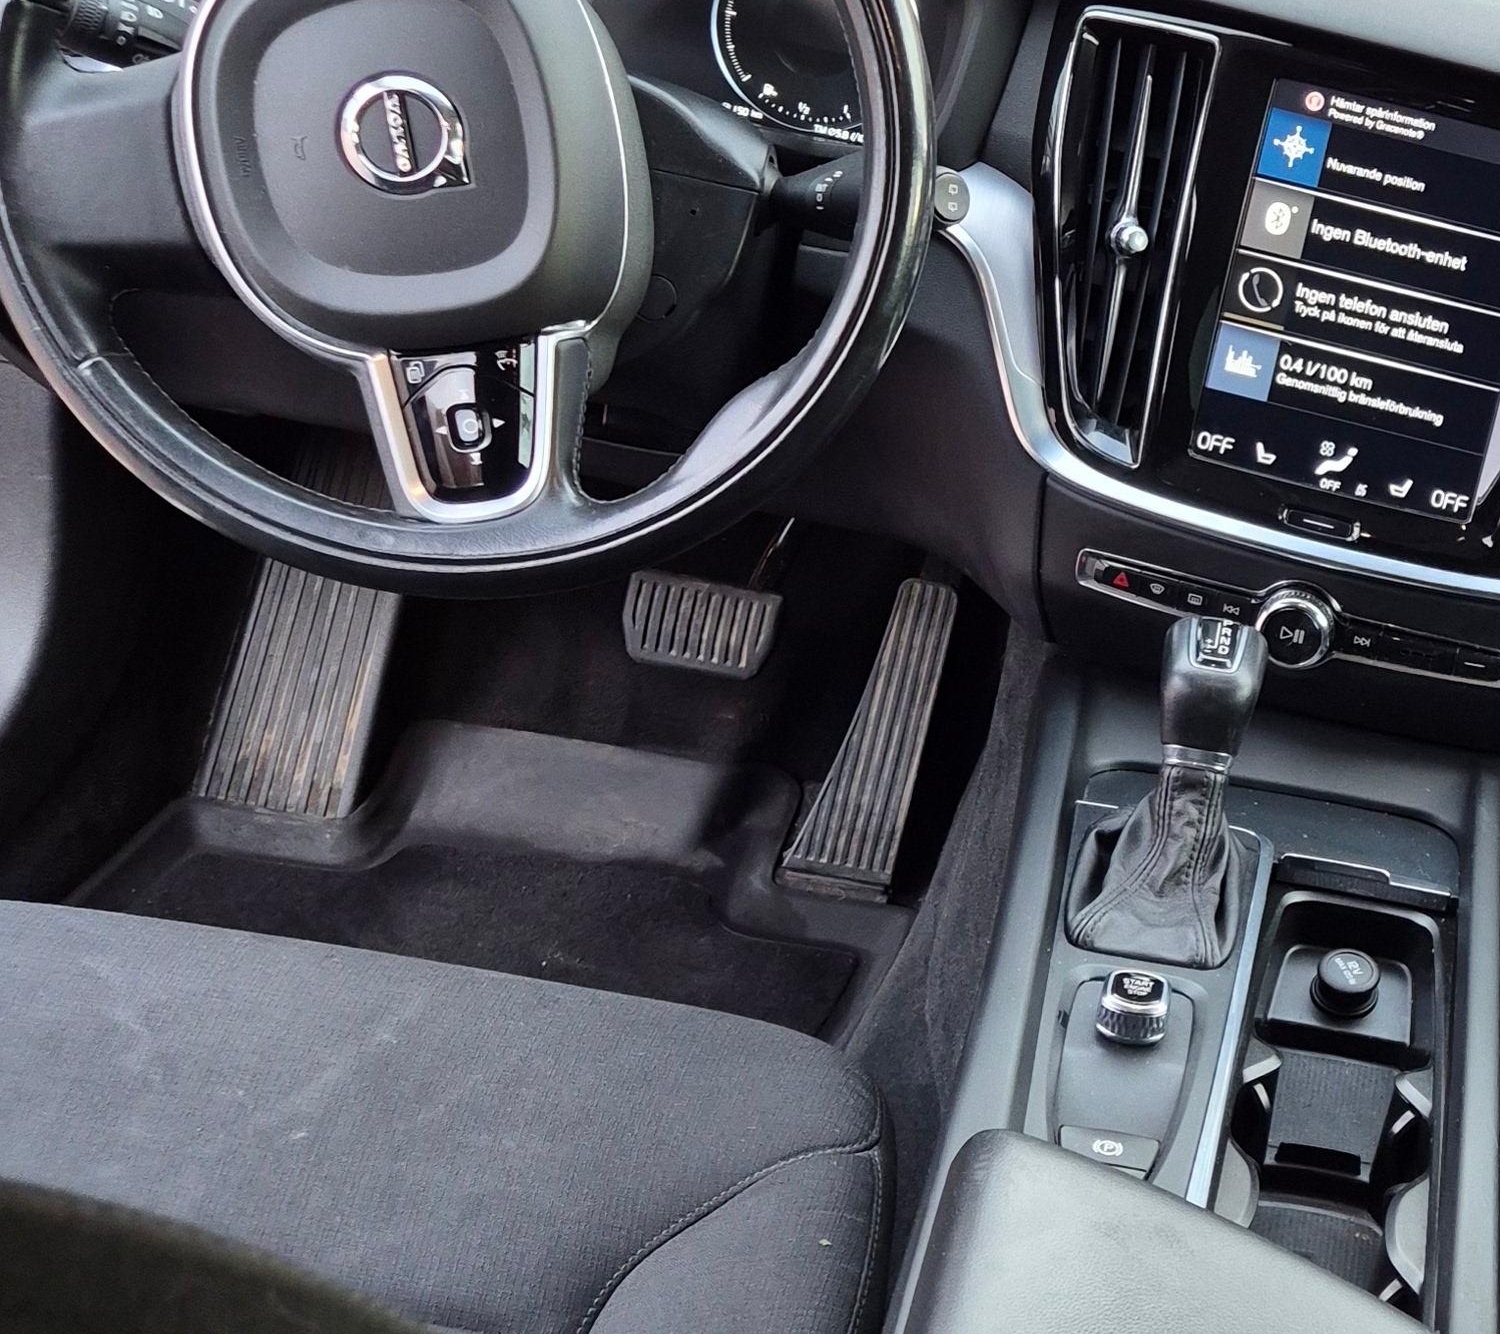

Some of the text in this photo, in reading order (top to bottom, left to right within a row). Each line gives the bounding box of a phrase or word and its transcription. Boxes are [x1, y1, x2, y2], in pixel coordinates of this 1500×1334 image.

[382, 91, 413, 173] VOLVO
[1365, 117, 1376, 130] by
[1383, 172, 1426, 193] position
[1310, 218, 1468, 272] Ingen Bluetooth-enhet
[1294, 300, 1321, 318] Tryck
[1321, 309, 1336, 323] på
[1337, 313, 1373, 331] ikonen
[1373, 319, 1391, 336] för
[1295, 282, 1450, 335] Ingen telefon ansluten
[1349, 371, 1374, 391] km
[1275, 372, 1444, 427] Genomsnittlig bränsleförbrukning
[1196, 430, 1236, 455] OFF
[1319, 477, 1342, 492] OFF
[1430, 489, 1470, 513] OFF
[1217, 645, 1230, 655] D
[1220, 636, 1231, 646] N
[1122, 977, 1156, 988] START
